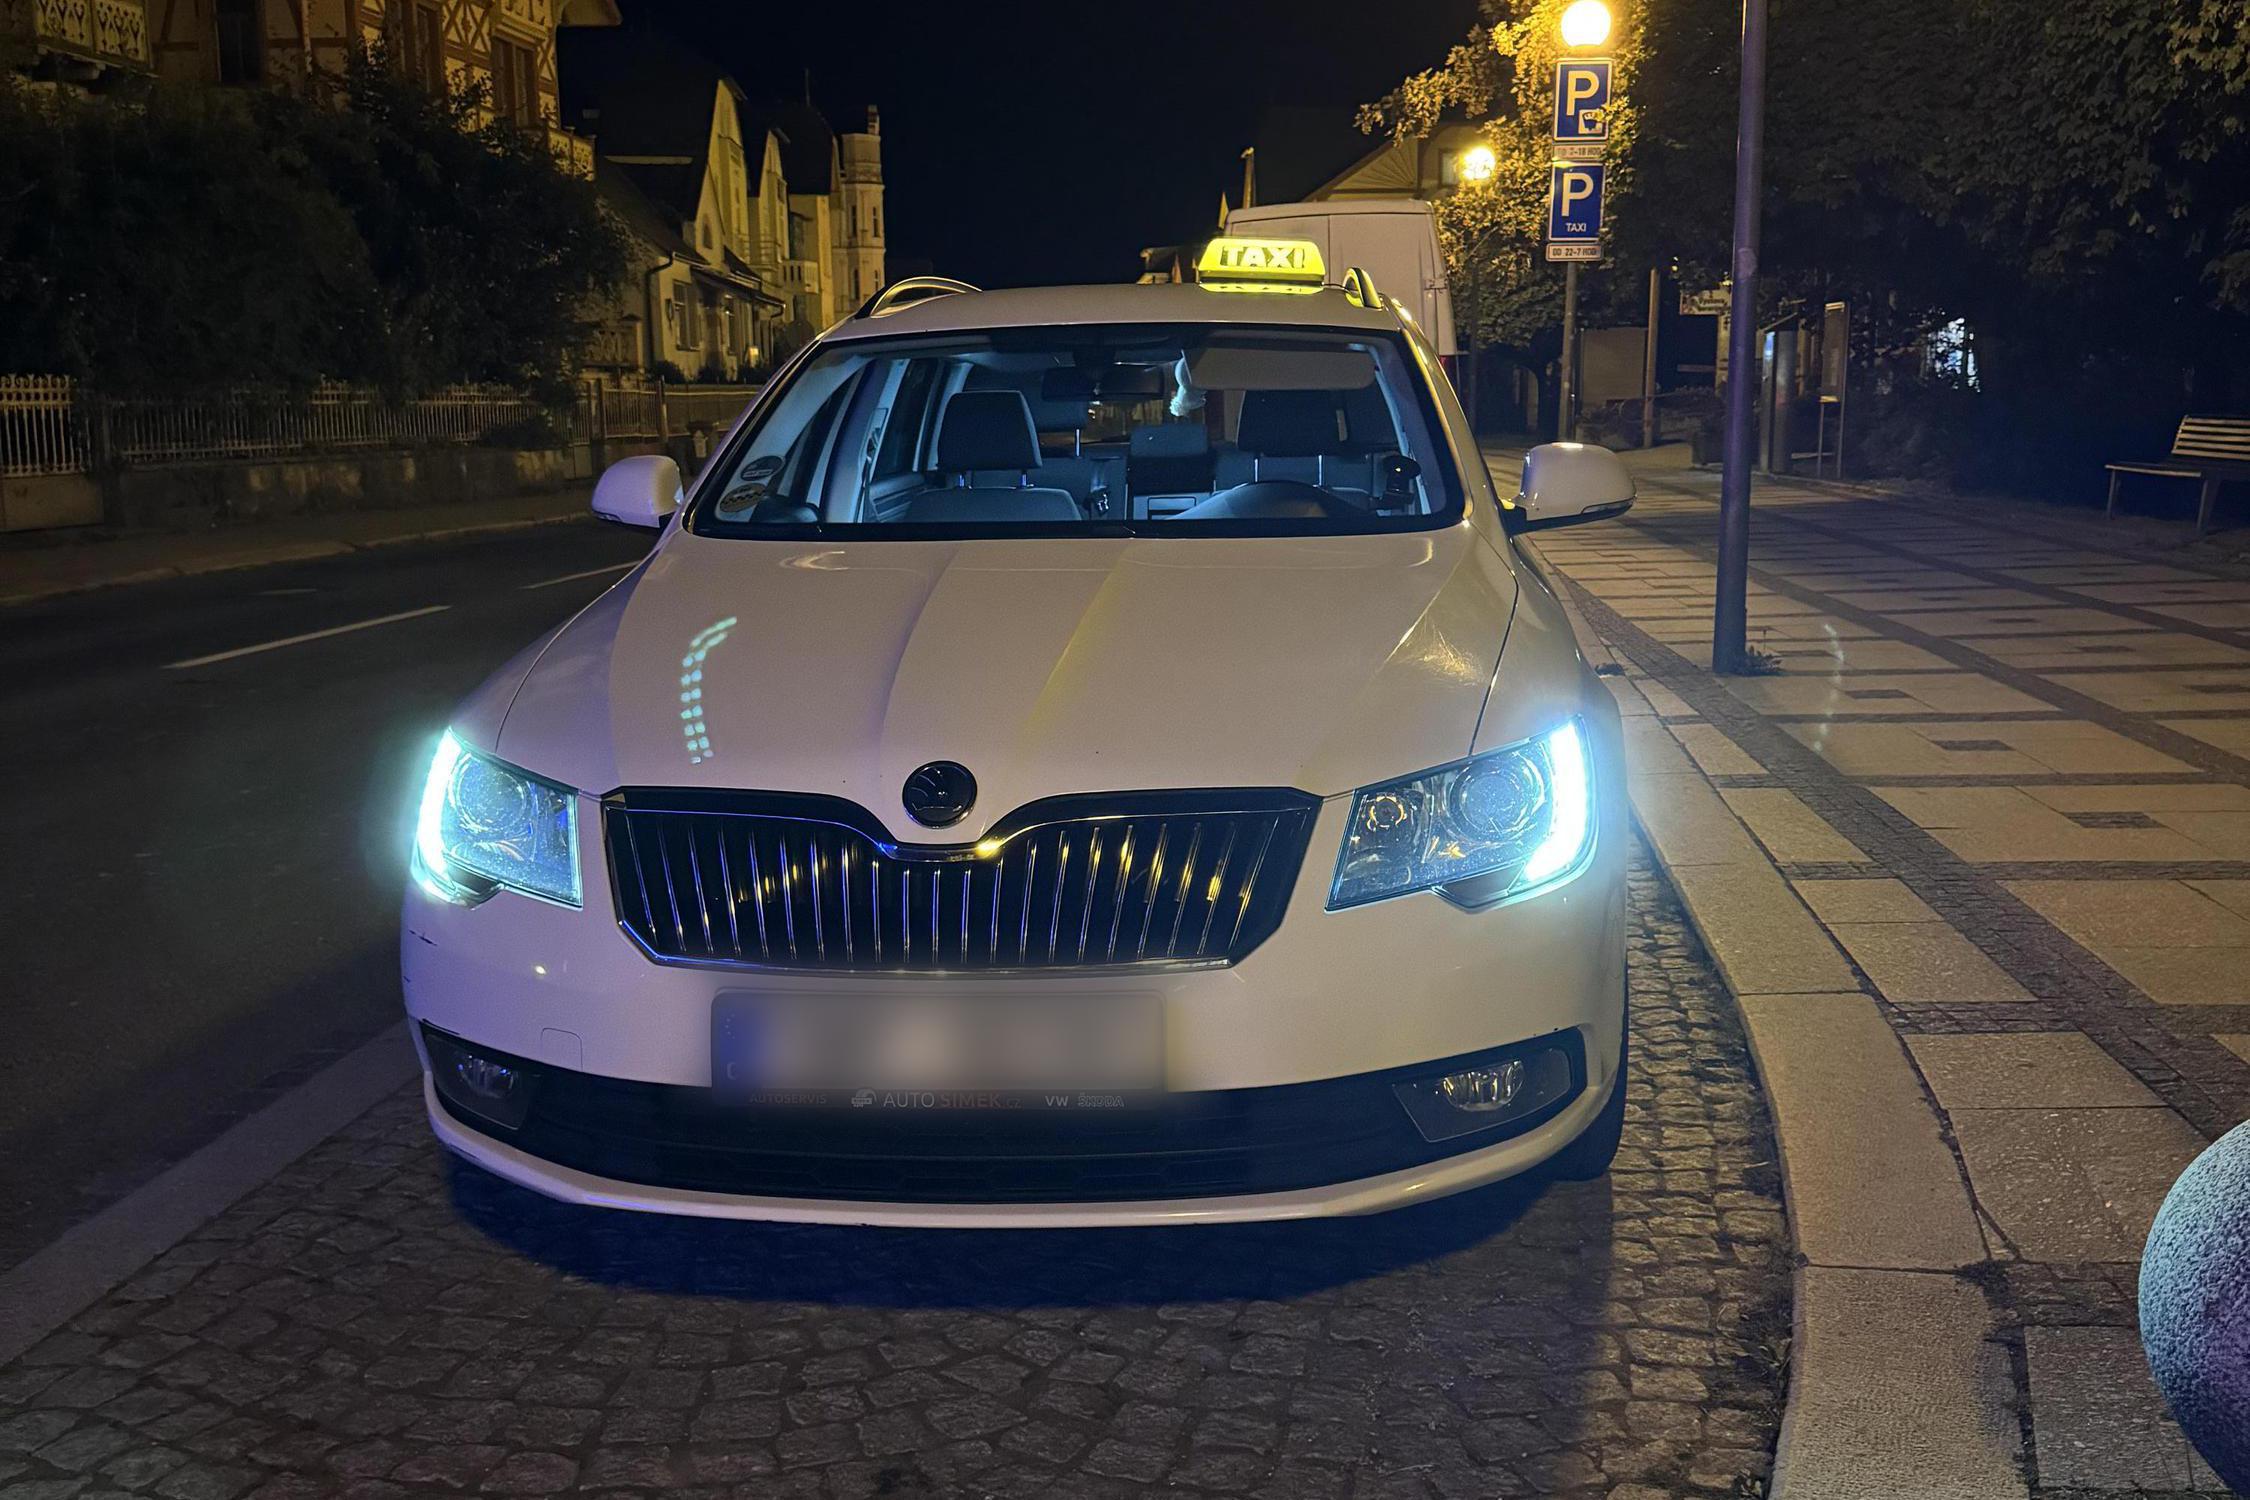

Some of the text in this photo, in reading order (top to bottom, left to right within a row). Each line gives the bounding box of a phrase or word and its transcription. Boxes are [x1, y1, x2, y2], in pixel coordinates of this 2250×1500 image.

[1566, 70, 1600, 116] P
[1561, 172, 1594, 217] P
[1565, 222, 1587, 232] TAXI
[1222, 246, 1305, 268] TAXI
[1565, 248, 1582, 256] 22-7
[750, 1093, 827, 1104] AUTOSERVIS
[883, 1092, 935, 1108] AUTO
[1045, 1095, 1069, 1107] VW
